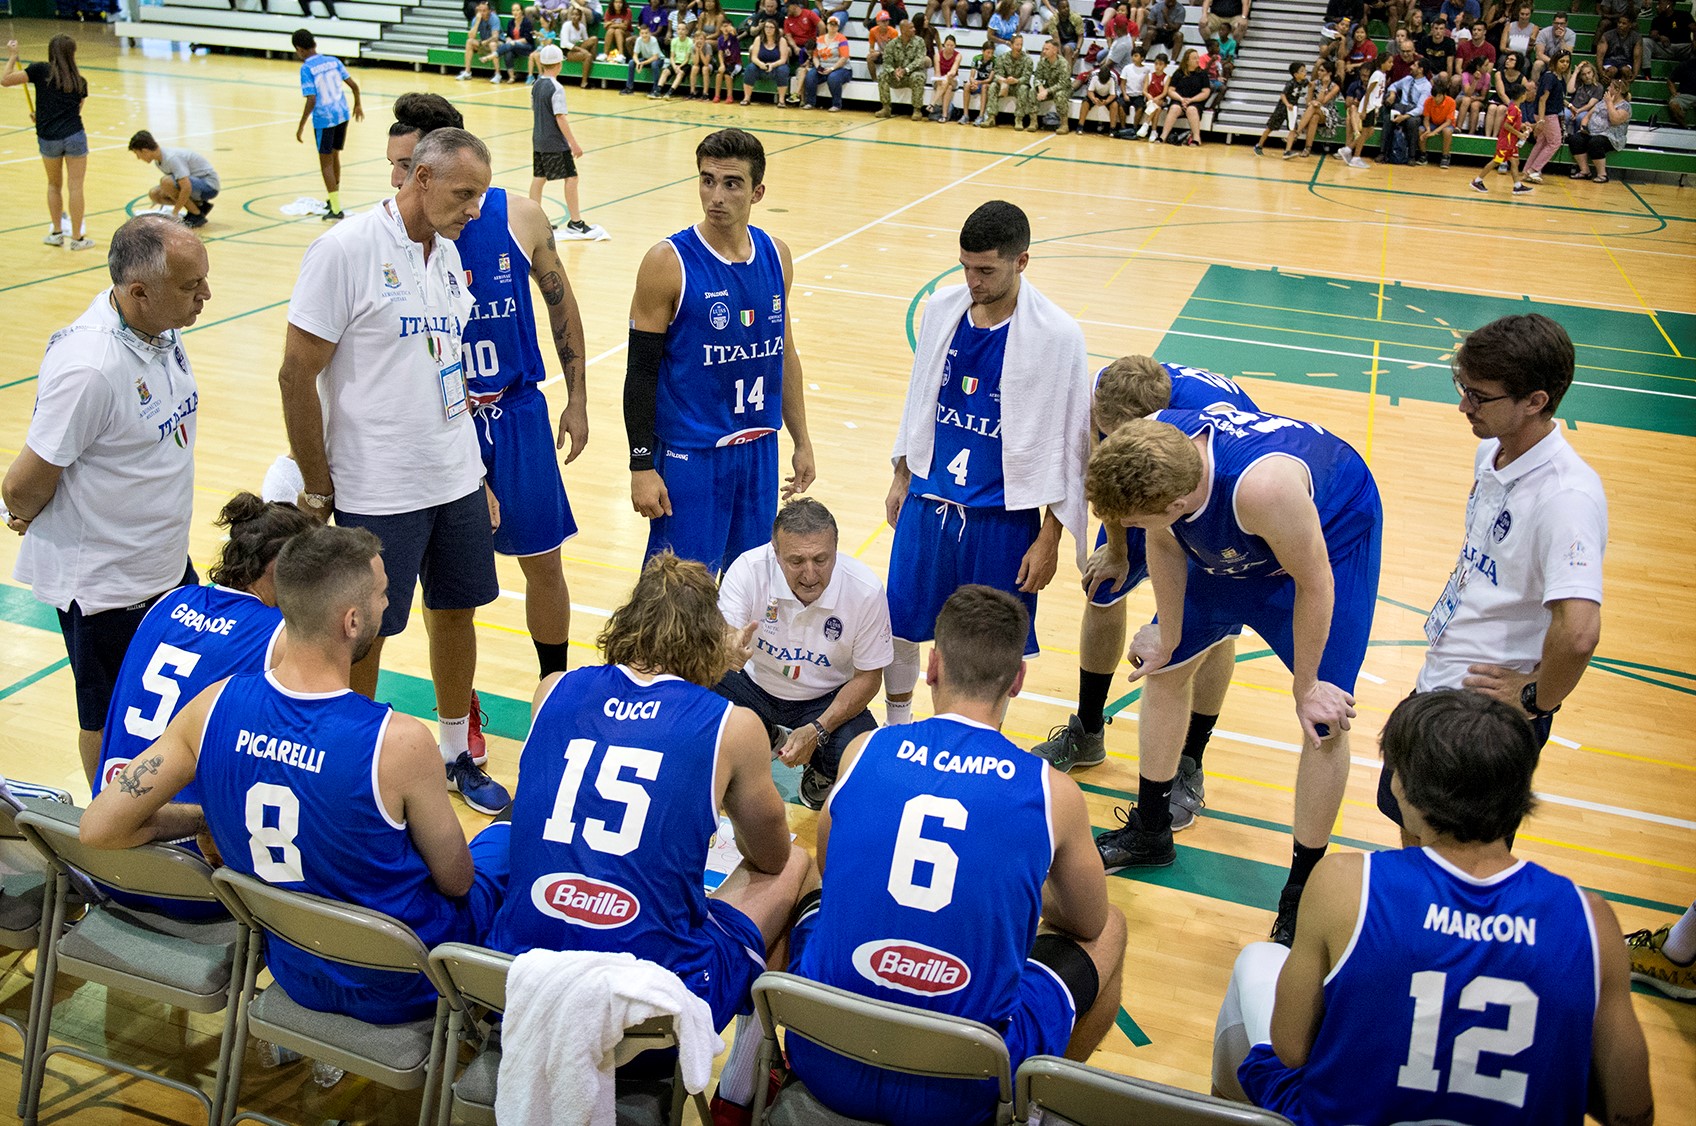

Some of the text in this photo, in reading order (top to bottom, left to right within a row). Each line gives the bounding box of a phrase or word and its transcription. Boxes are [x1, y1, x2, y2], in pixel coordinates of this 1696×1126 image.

[468, 297, 516, 320] LIA
[461, 340, 499, 379] 10
[703, 336, 784, 366] ITALIA
[734, 376, 765, 414] 14
[158, 391, 199, 443] ITALIA
[946, 448, 971, 486] 4
[170, 603, 238, 636] GRANDE
[757, 637, 831, 667] ITALIA
[124, 641, 202, 741] 5
[604, 697, 661, 721] CUCCI
[235, 729, 326, 774] PICARELLI
[897, 740, 1016, 780] DA CAMPO
[542, 738, 664, 857] 15
[245, 781, 306, 883] 8
[887, 793, 969, 913] 6
[552, 884, 631, 917] Barilla
[1423, 903, 1536, 946] MARCON
[877, 950, 961, 985] Barilla
[1397, 970, 1540, 1109] 12
